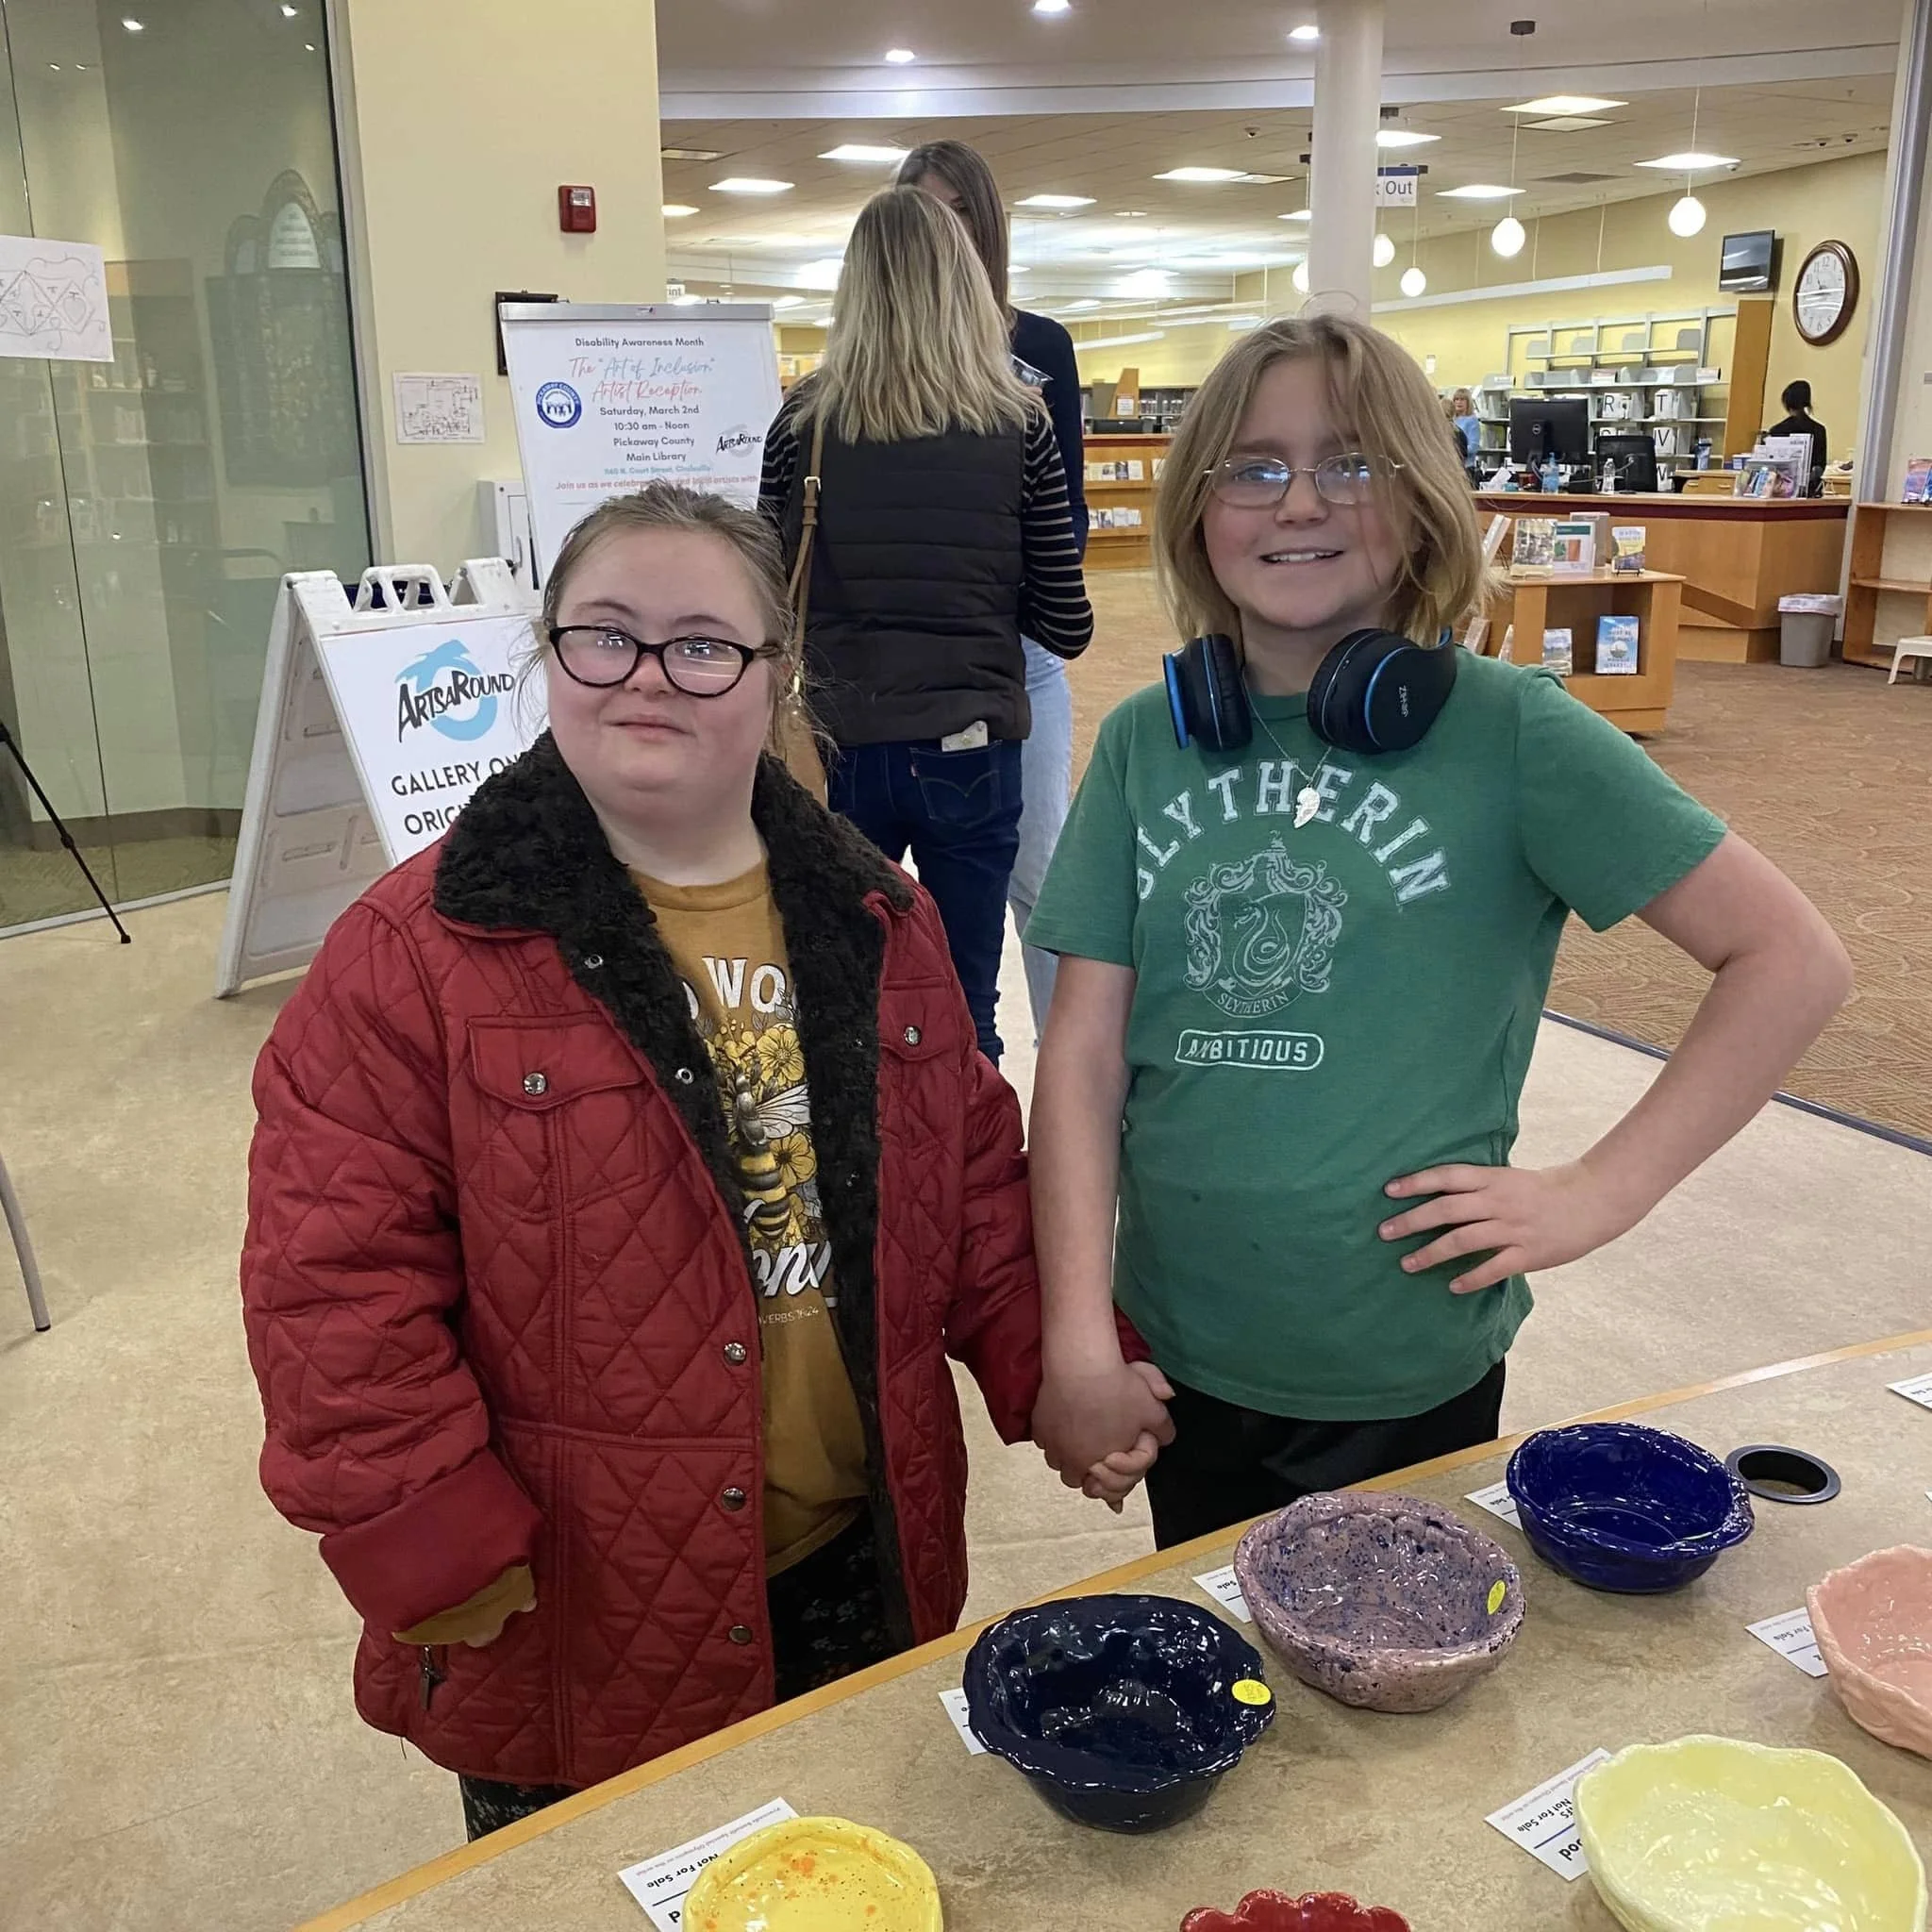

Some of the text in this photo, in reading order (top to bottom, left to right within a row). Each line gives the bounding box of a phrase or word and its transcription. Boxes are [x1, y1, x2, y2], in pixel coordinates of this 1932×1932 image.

[1386, 180, 1412, 194] Out
[575, 337, 704, 349] Disability Awareness Month
[570, 357, 596, 378] The
[631, 360, 644, 379] of
[591, 380, 633, 402] Artist
[634, 379, 702, 401] Reception
[1605, 395, 1614, 412] R
[1657, 394, 1668, 412] T
[599, 404, 700, 418] Saturday, March 2nd
[614, 422, 640, 431] 10:30
[664, 421, 690, 430] Noon
[613, 436, 695, 448] Pickaway County
[1657, 429, 1670, 447] V
[625, 451, 687, 462] Main Library
[556, 481, 575, 490] Join
[391, 761, 481, 796] GALLERY
[1217, 990, 1290, 1014] SLYTHERIN
[1184, 1038, 1308, 1062] AMBITIOUS
[1552, 1798, 1573, 1812] Not
[1538, 1808, 1555, 1823] For
[1516, 1819, 1540, 1833] Sale
[646, 1852, 720, 1890] Not For Sale
